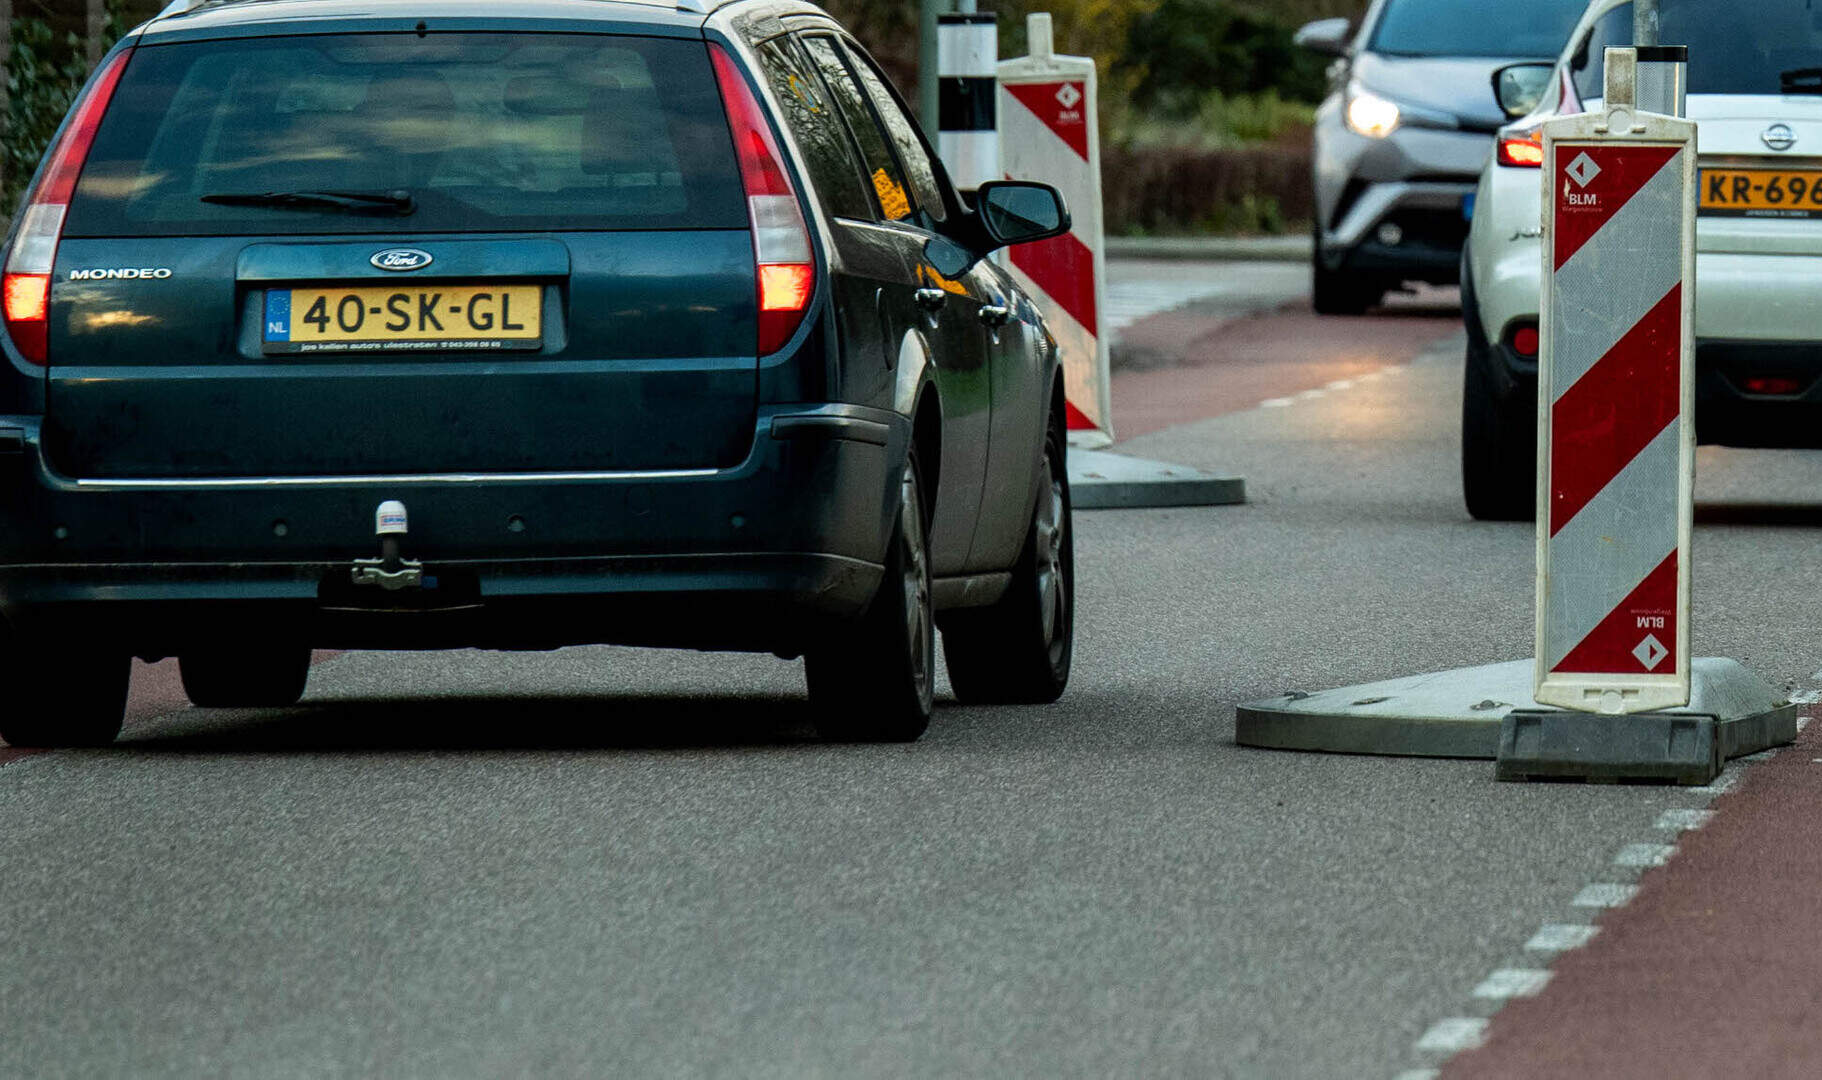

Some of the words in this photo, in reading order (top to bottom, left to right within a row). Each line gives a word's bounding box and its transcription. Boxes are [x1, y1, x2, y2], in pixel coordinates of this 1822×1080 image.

[1569, 193, 1597, 206] BLM
[383, 251, 418, 266] Ford
[69, 268, 172, 280] MONDEO
[303, 292, 524, 334] 40-SK-GL
[268, 322, 288, 334] NL
[1637, 617, 1665, 629] BLM
